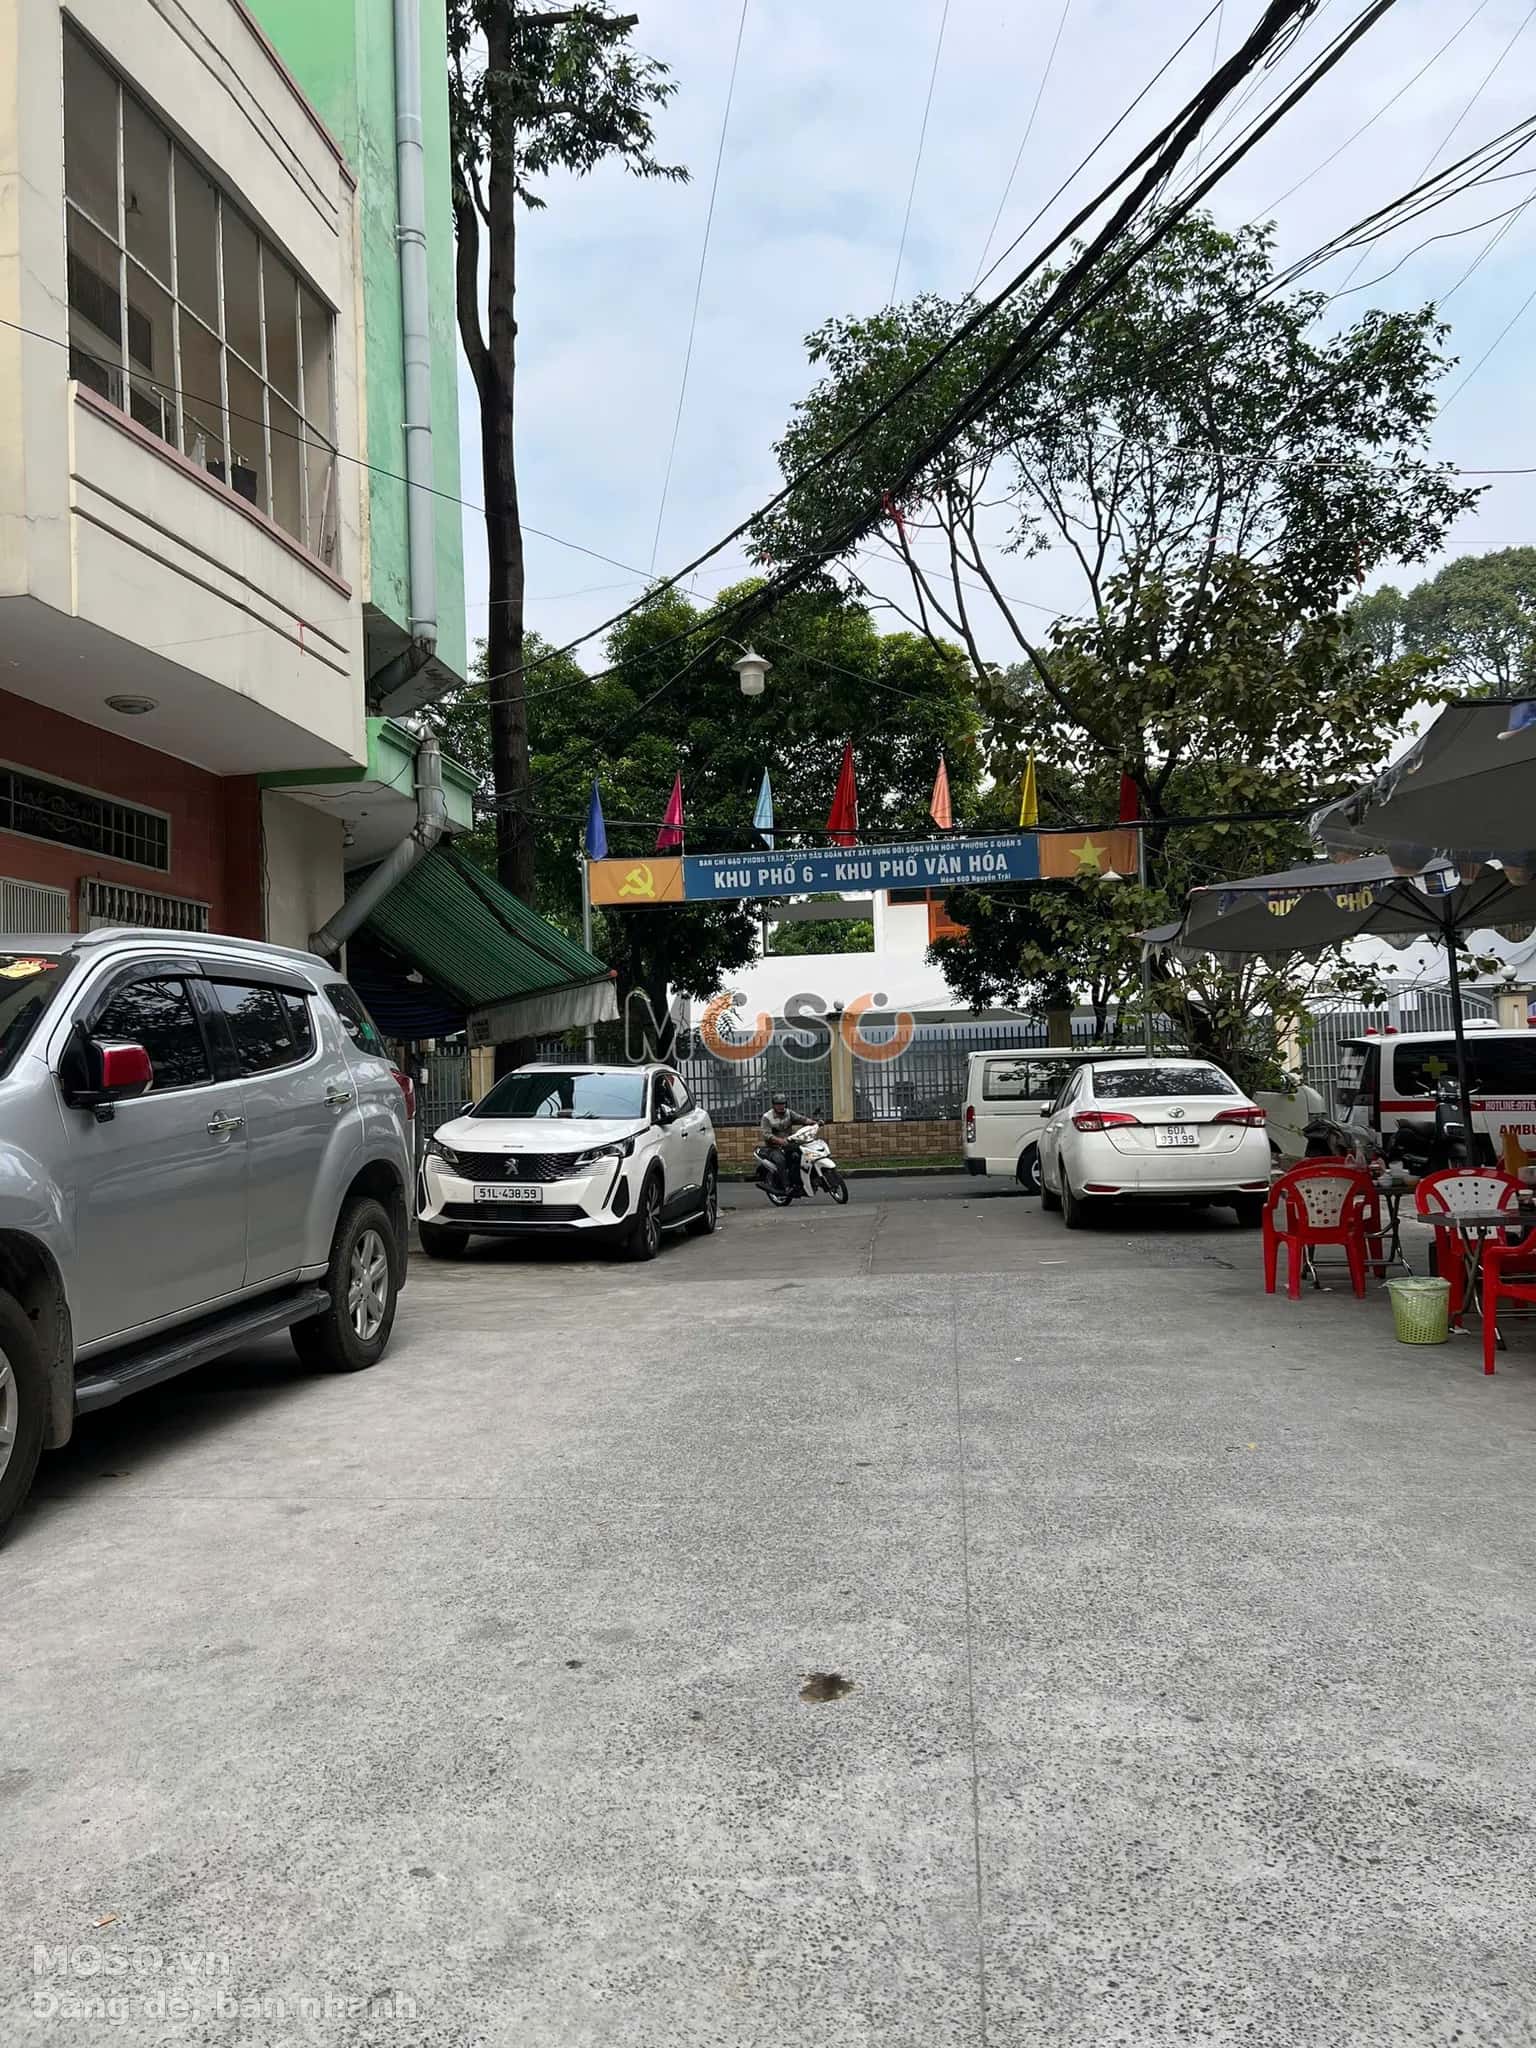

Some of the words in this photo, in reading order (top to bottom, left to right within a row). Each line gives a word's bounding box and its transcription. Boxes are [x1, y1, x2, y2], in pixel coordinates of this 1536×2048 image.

[714, 868, 750, 889] KHU
[758, 861, 796, 887] PHỐ
[803, 866, 814, 884] 6
[835, 862, 872, 881] KHU
[879, 853, 918, 878] PHỐ
[924, 854, 961, 875] VĂN
[968, 850, 1008, 873] HÓA
[1167, 1126, 1186, 1135] 60A
